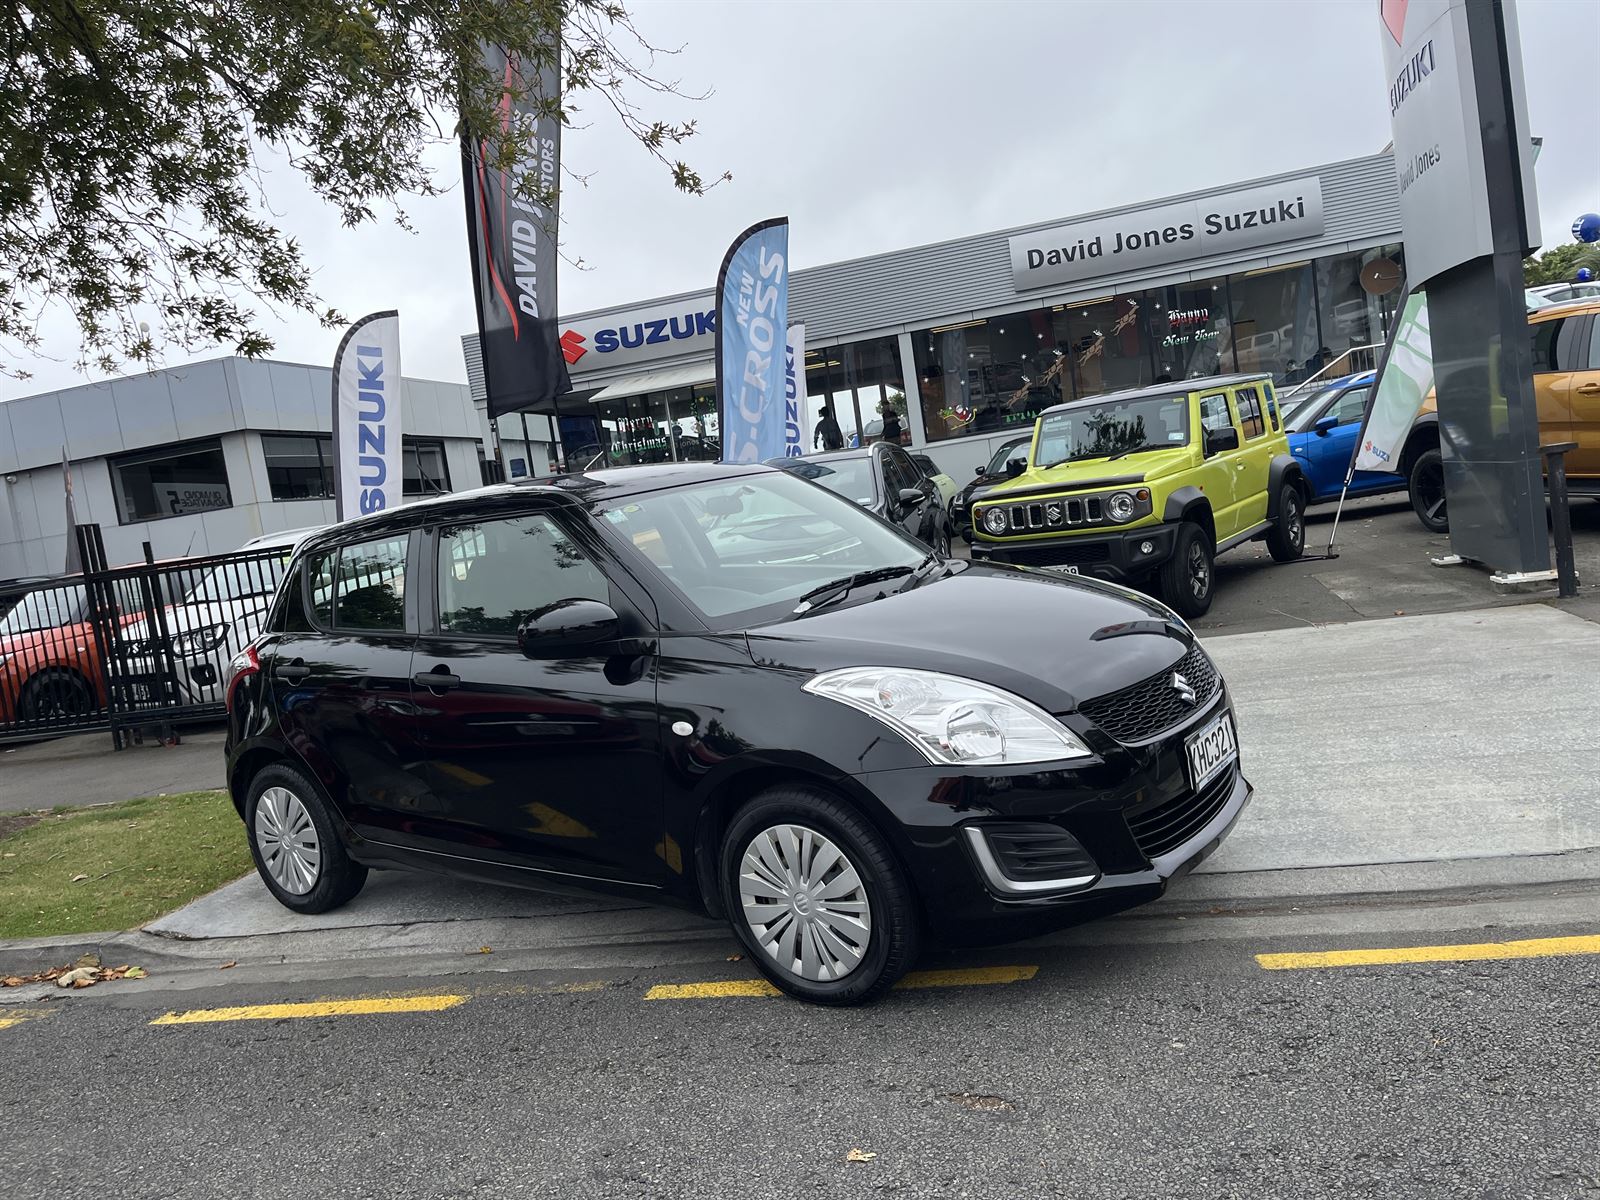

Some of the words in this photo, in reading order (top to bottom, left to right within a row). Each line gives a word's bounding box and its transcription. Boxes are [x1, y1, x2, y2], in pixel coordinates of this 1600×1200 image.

[541, 138, 554, 207] OTORS
[1415, 143, 1440, 179] Jones
[1027, 236, 1103, 270] David
[1113, 222, 1194, 254] Jones
[1204, 196, 1305, 236] Suzuki
[511, 219, 539, 319] DAVID
[736, 270, 755, 328] NEW
[1168, 308, 1208, 327] Happy
[593, 310, 716, 353] SUZUK
[728, 246, 785, 463] S-CROSS
[1163, 334, 1189, 347] New
[1195, 329, 1220, 341] Year
[356, 344, 387, 516] SUZUKI
[617, 415, 660, 436] Merry
[785, 345, 802, 458] SUZUKI
[611, 437, 667, 458] Christmas
[1372, 446, 1390, 462] SUZ
[1192, 721, 1233, 778] KHC321
